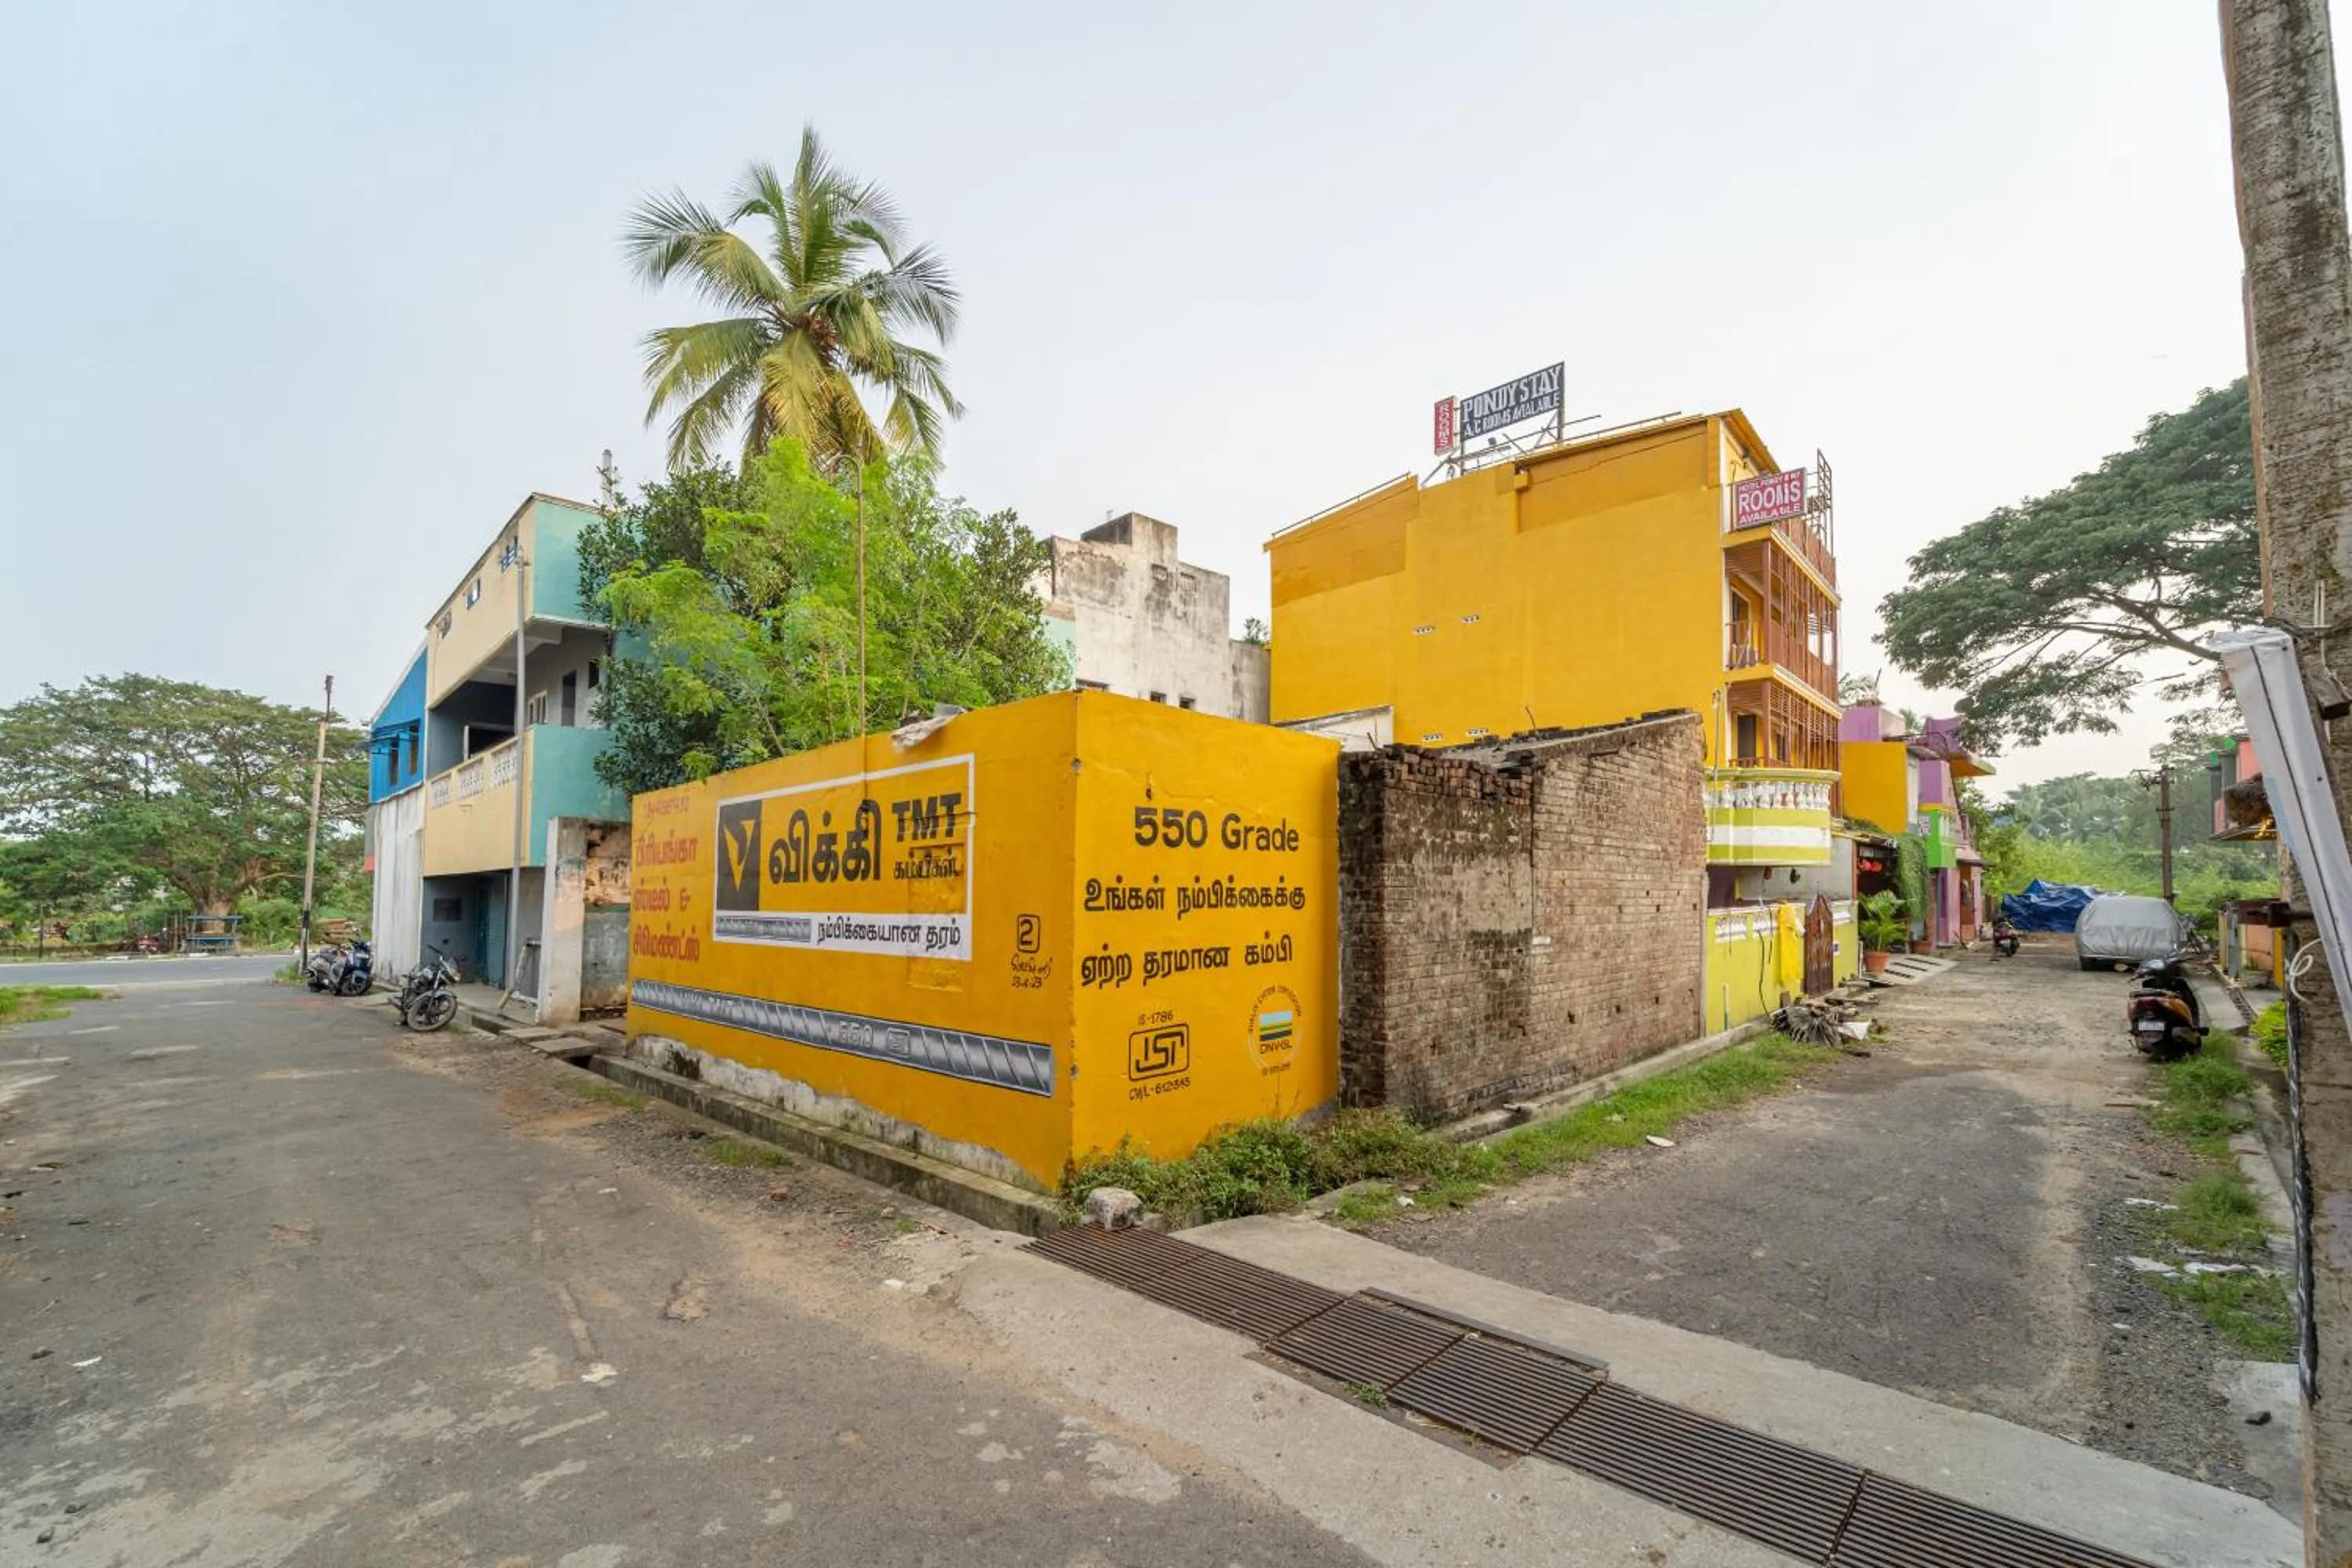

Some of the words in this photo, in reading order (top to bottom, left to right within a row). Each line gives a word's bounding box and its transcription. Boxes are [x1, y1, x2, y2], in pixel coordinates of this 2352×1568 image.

[1462, 383, 1519, 423] PONDY
[1520, 365, 1563, 401] STAY
[1483, 410, 1511, 433] ROOMS
[1738, 481, 1802, 514] ROOMS
[1738, 503, 1802, 524] AVAILABLE
[891, 793, 962, 843] TMT
[1134, 806, 1208, 848] 550
[1221, 813, 1299, 852] Grade
[768, 798, 882, 884] விக்கி
[1083, 875, 1166, 912] உங்கள்
[1177, 874, 1305, 920] நம்பிக்கைக்கு
[817, 915, 922, 946] நம்பிக்கையான
[926, 916, 961, 953] தரம்
[1020, 918, 1033, 946] 2
[1080, 943, 1132, 990] ஏற்ற
[1142, 946, 1230, 986] தரமான
[1243, 931, 1293, 966] கம்பி
[840, 1020, 873, 1048] 550
